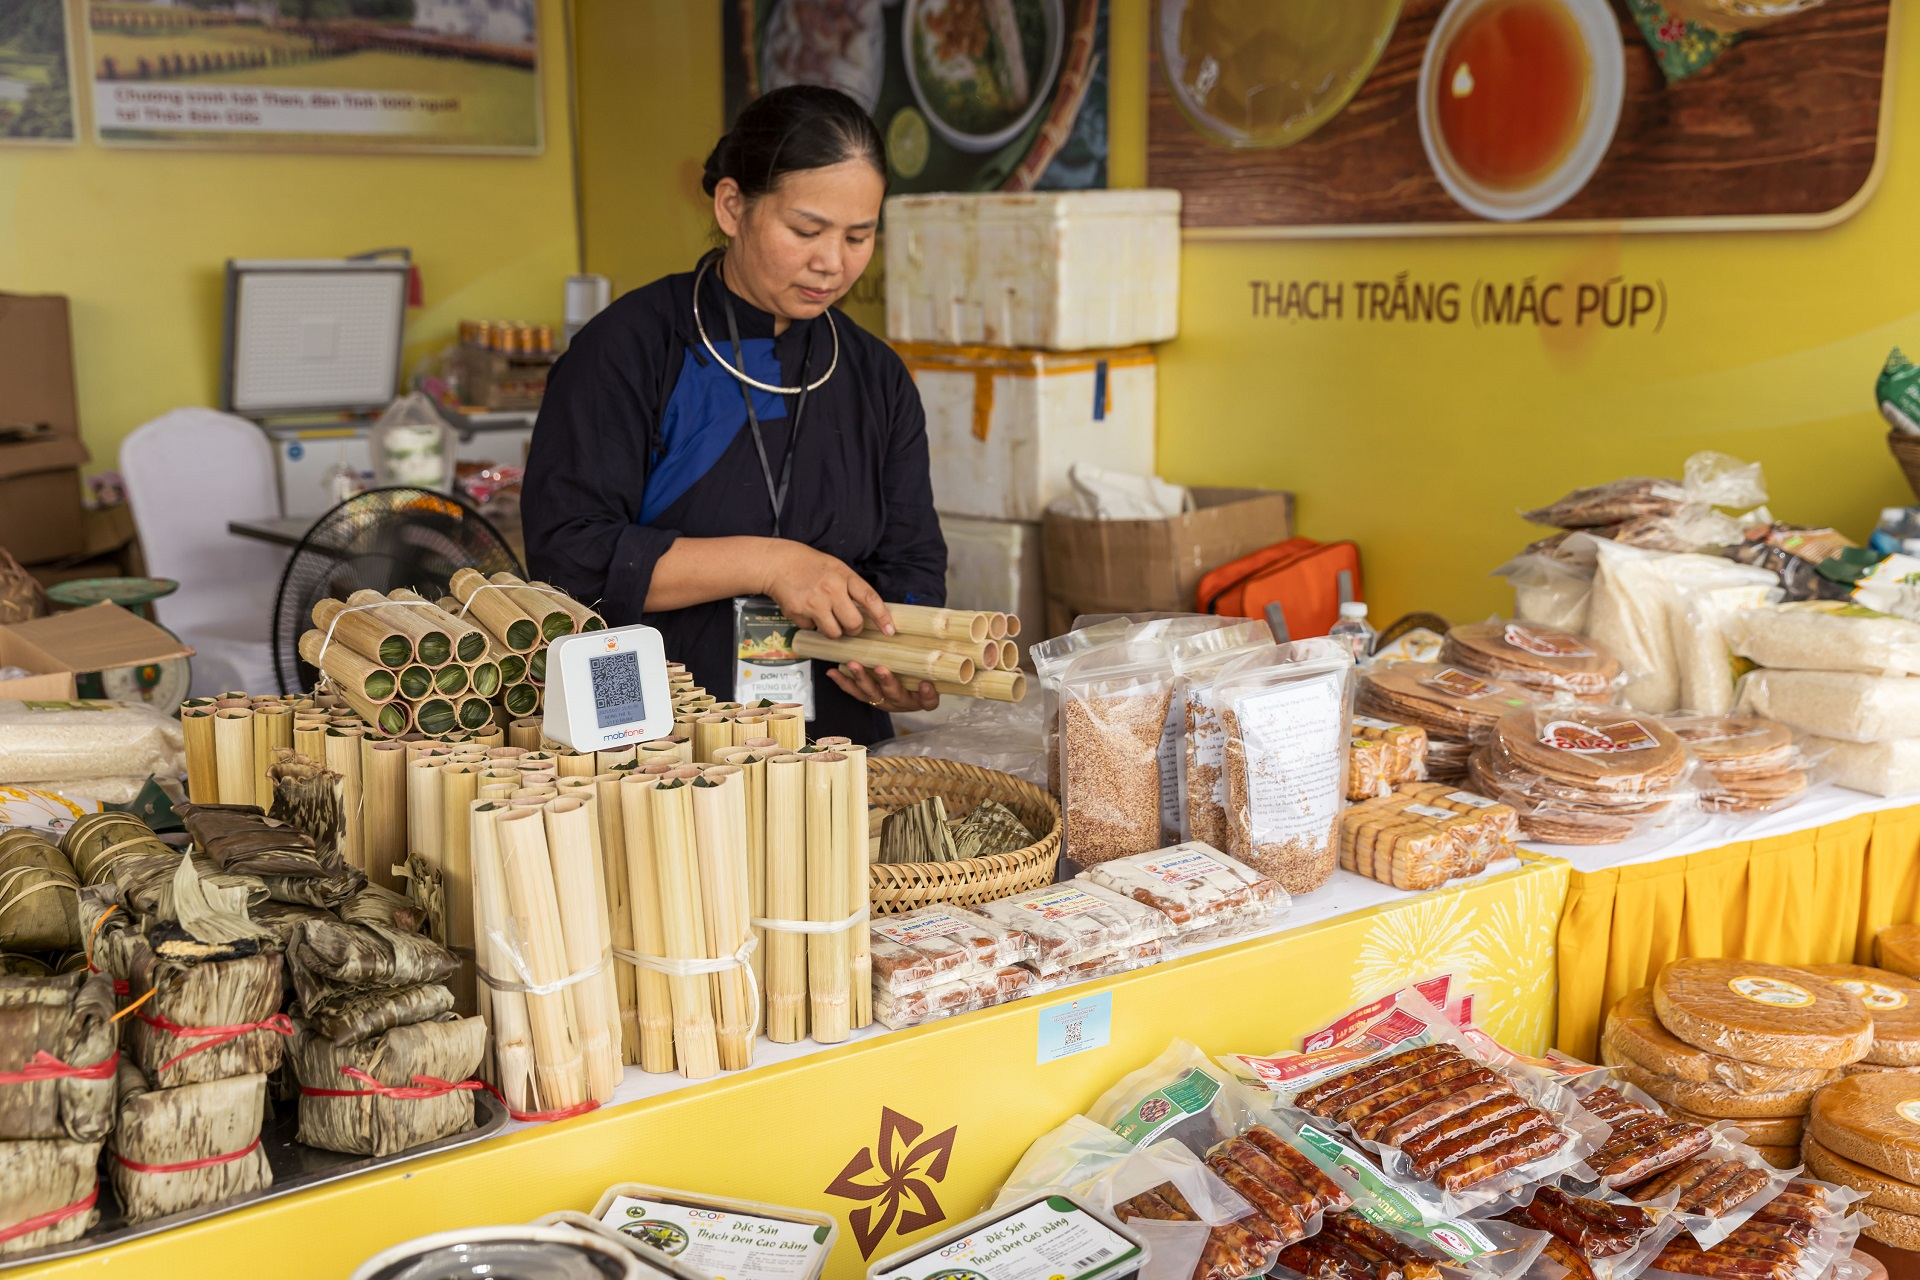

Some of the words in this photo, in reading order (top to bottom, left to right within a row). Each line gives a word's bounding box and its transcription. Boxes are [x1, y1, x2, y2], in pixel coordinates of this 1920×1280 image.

[1249, 281, 1343, 325] THẠCH
[1353, 270, 1459, 323] TRẮNG
[760, 672, 778, 680] ĐƠN
[603, 728, 644, 741] mobifone
[688, 1209, 726, 1221] OCOP
[697, 1228, 735, 1241] Thạch
[730, 1234, 753, 1245] Đen
[755, 1238, 776, 1248] Cao
[731, 1221, 754, 1232] Đặc
[756, 1224, 779, 1236] Sản
[985, 1231, 1006, 1244] Đặc
[1006, 1221, 1027, 1235] Sản
[940, 1238, 973, 1257] OCOP
[969, 1248, 1002, 1266] Thạch
[1002, 1240, 1022, 1254] Đen
[1022, 1231, 1041, 1243] Cao
